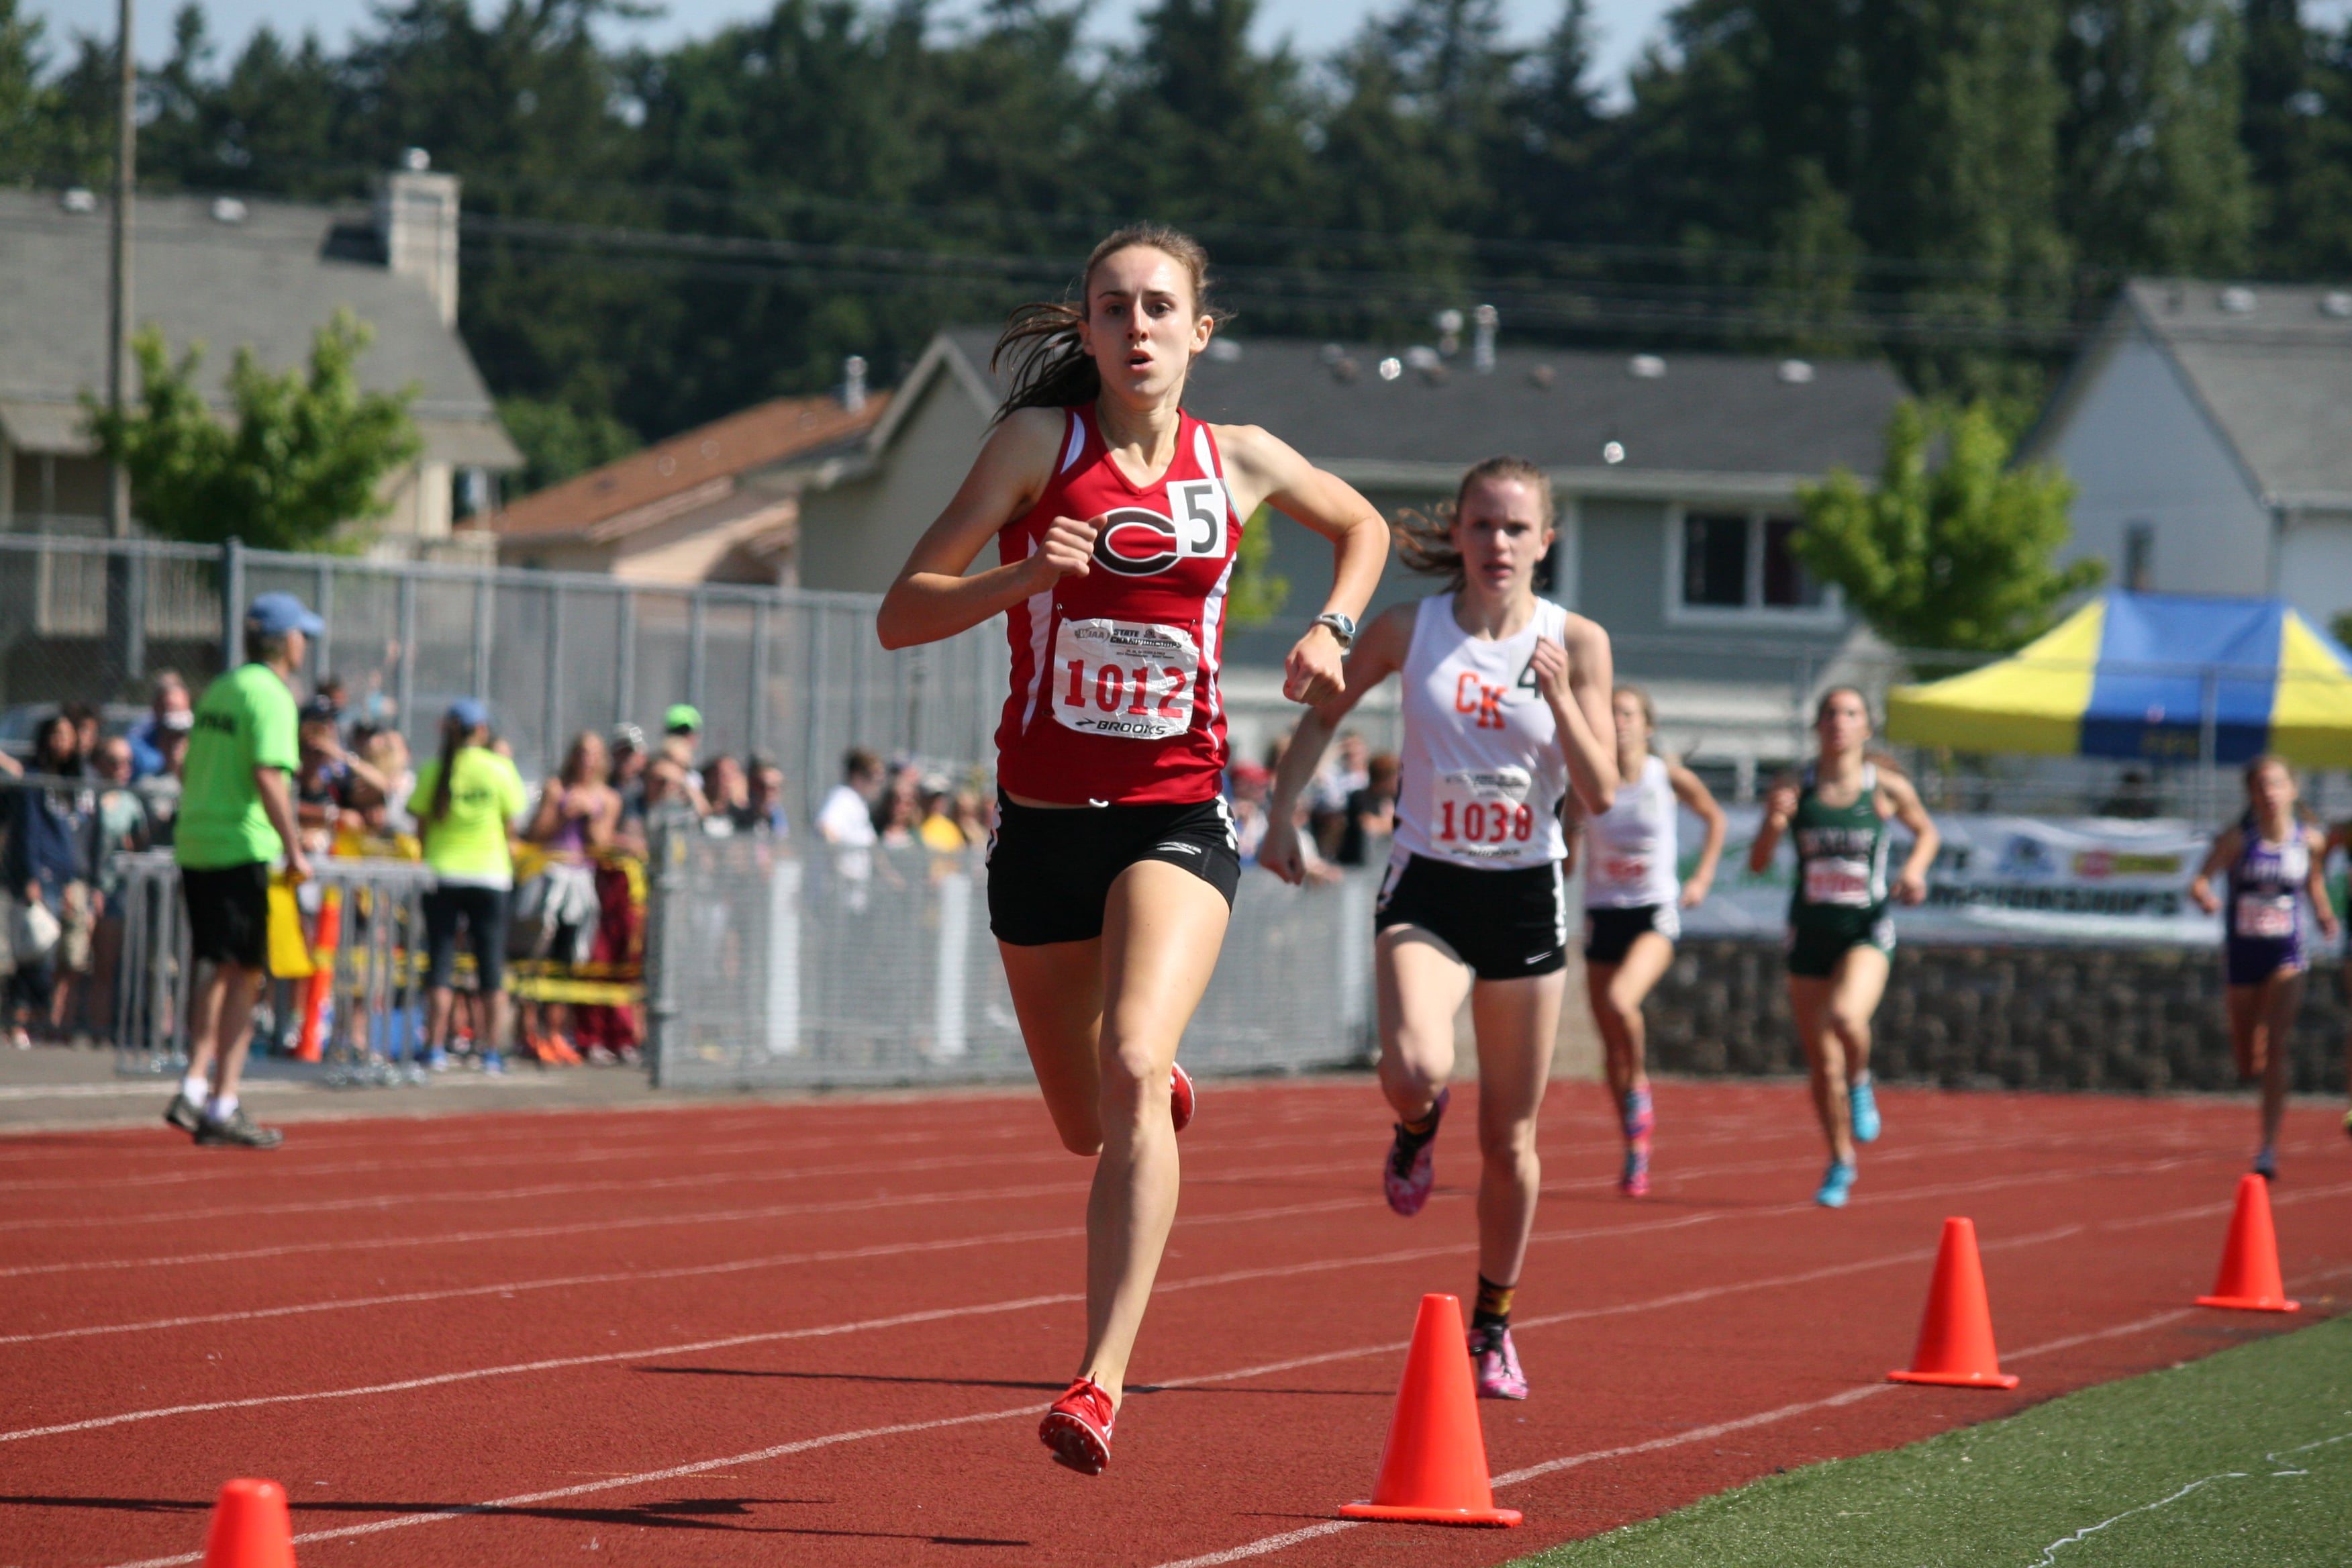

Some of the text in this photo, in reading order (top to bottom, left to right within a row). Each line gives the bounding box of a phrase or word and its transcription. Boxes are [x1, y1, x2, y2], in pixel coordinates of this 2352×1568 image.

[1183, 484, 1218, 553] 5
[1092, 507, 1182, 577] C
[1077, 629, 1105, 639] WIAA
[1110, 637, 1182, 649] CHAMPIONSHIPS
[1113, 628, 1140, 637] STATE
[1065, 659, 1187, 718] 1012
[1455, 671, 1508, 730] CK
[1097, 720, 1167, 735] BROOKS
[1441, 801, 1534, 844] 1038
